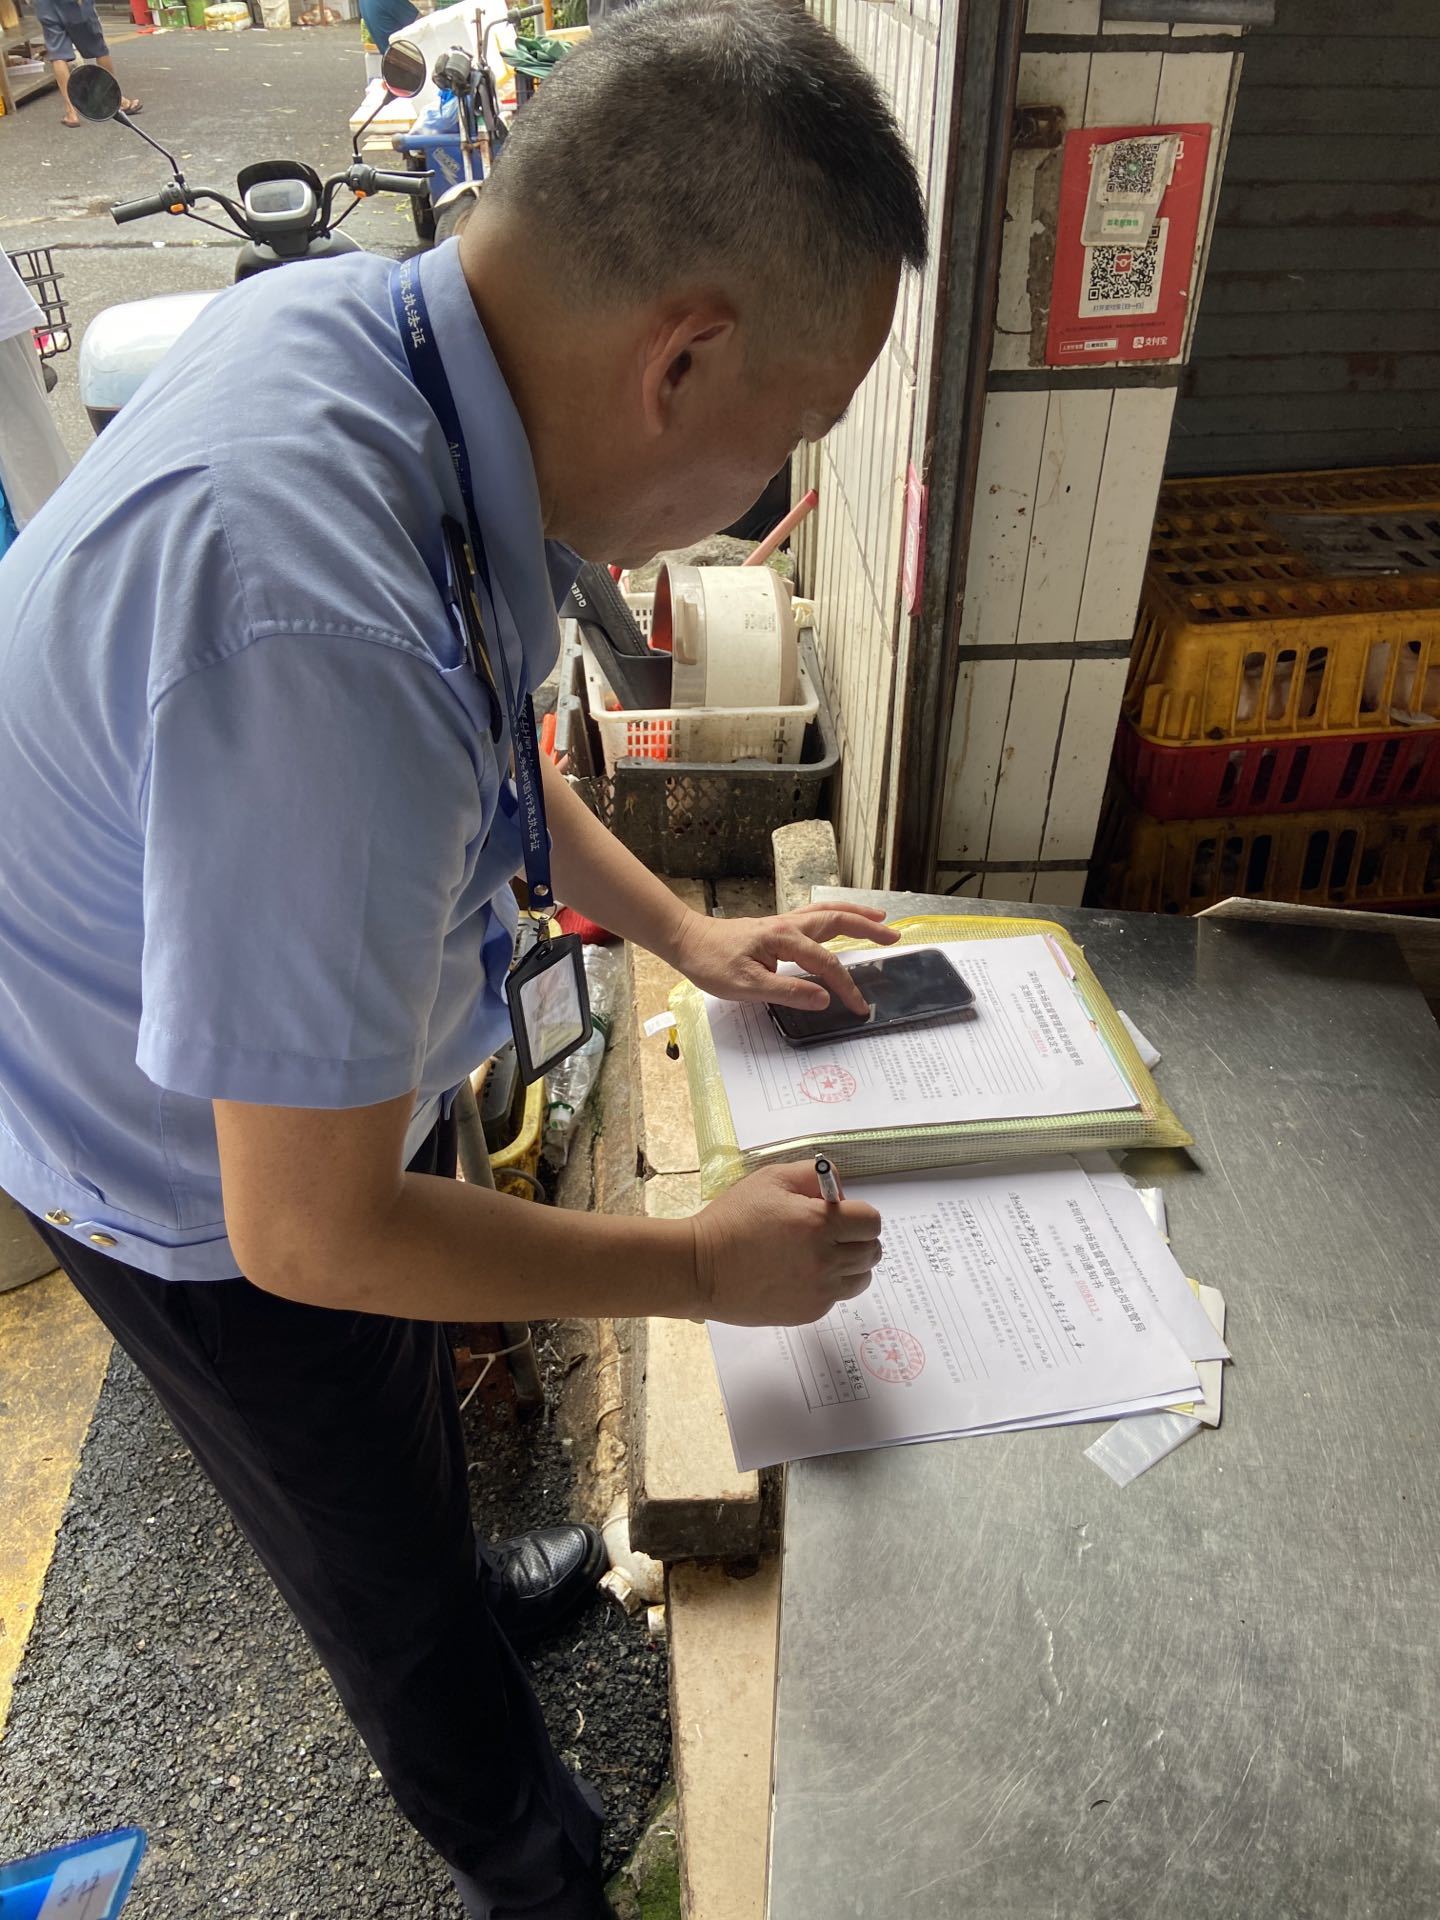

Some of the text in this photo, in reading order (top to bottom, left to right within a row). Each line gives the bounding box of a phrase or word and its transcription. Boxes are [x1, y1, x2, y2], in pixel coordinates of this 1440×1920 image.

[1144, 336, 1168, 346] 支付宝
[1066, 1199, 1146, 1332] 深圳市市场监督管理局龙岗监管局
[1073, 1244, 1104, 1289] 询问通知书
